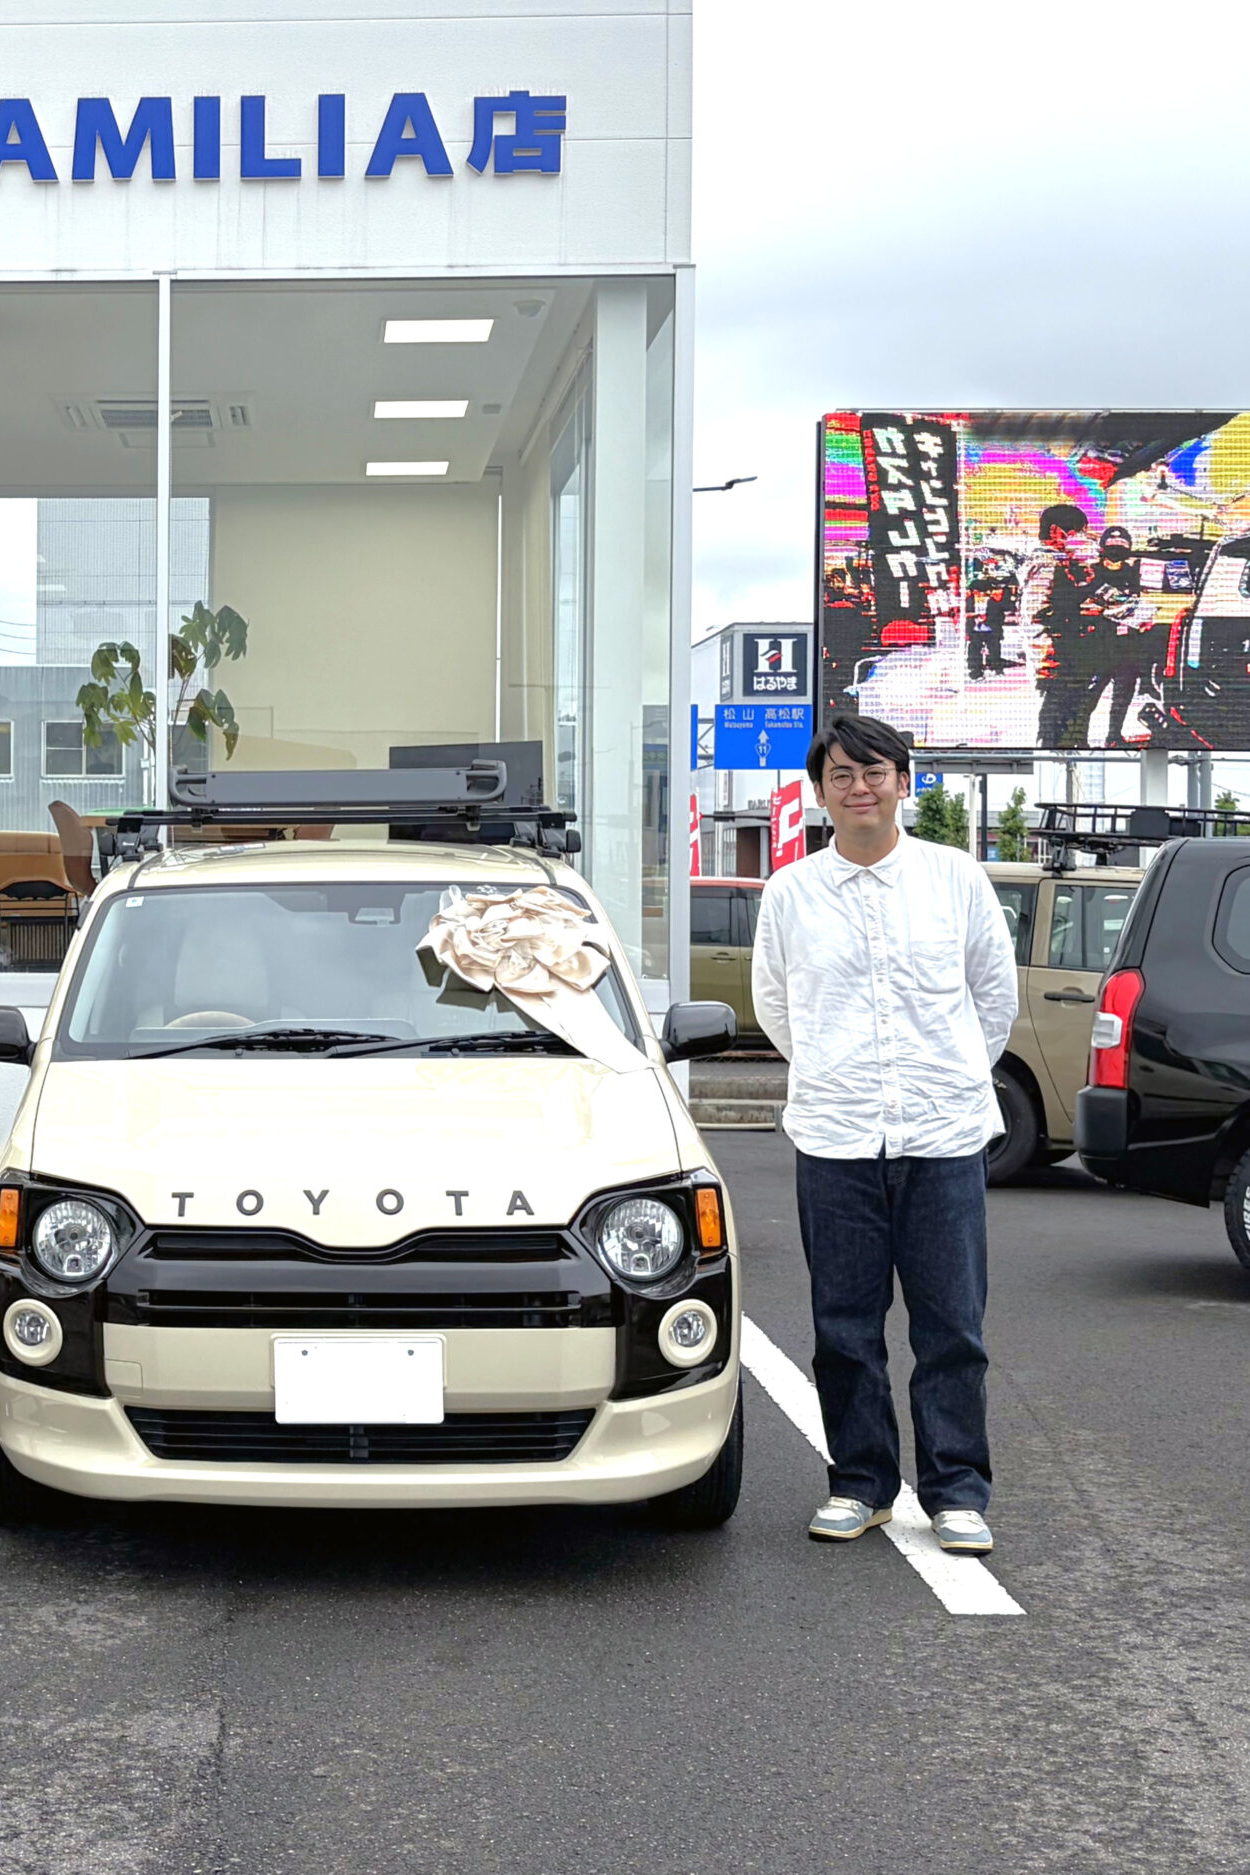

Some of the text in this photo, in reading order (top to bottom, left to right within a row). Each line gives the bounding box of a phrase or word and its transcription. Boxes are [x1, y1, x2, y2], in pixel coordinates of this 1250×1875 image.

[753, 676, 798, 691] はるやま
[764, 708, 805, 721] 高松駅
[758, 745, 768, 754] 11
[171, 1188, 535, 1217] TOYOTA
